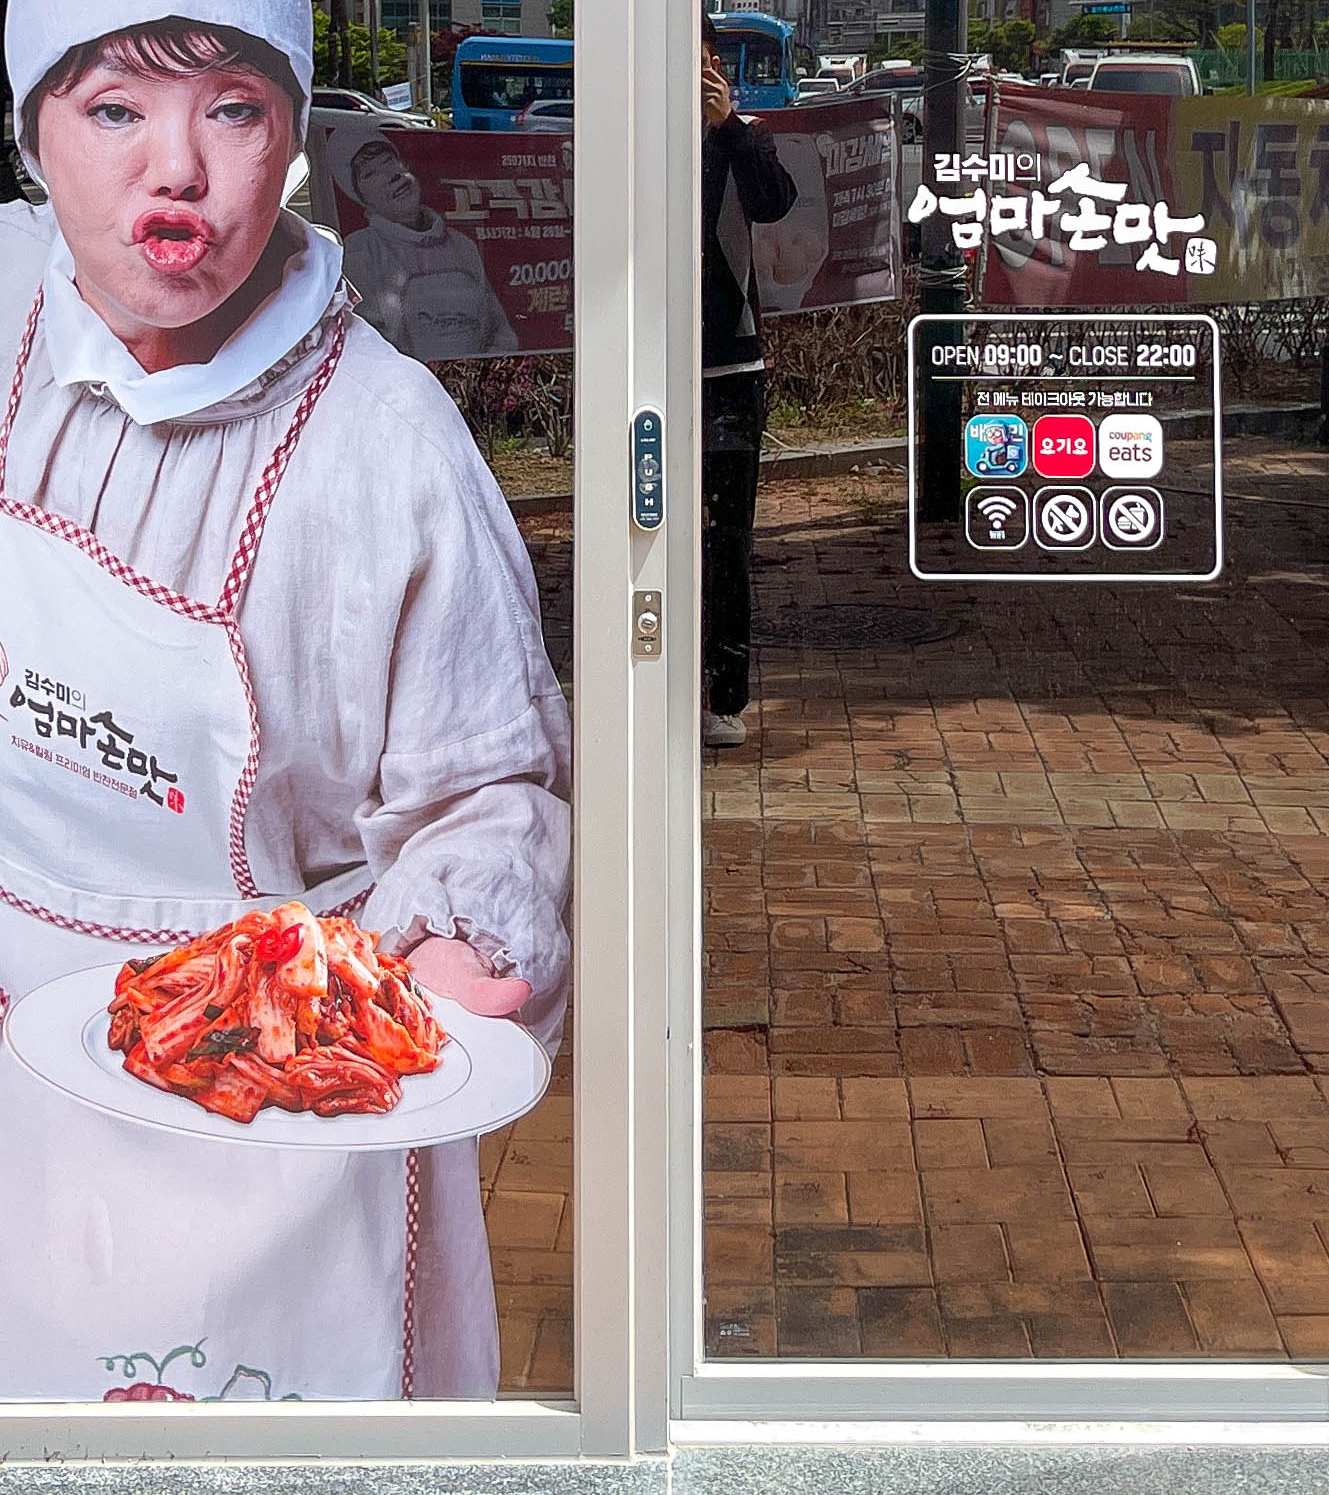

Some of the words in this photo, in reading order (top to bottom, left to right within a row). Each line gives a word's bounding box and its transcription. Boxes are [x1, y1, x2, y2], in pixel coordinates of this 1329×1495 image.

[933, 153, 1042, 183] 김수미의
[907, 162, 1206, 276] 엄마손맛
[931, 346, 980, 367] OPEN
[983, 344, 1042, 367] 09:00
[1069, 346, 1129, 367] CLOSE
[1136, 344, 1196, 367] 22:00
[1039, 437, 1089, 455] 요기요
[1109, 431, 1153, 443] coupang
[1109, 446, 1152, 462] eats
[25, 668, 86, 712] 김수미의
[10, 684, 179, 807] 엄마손맛
